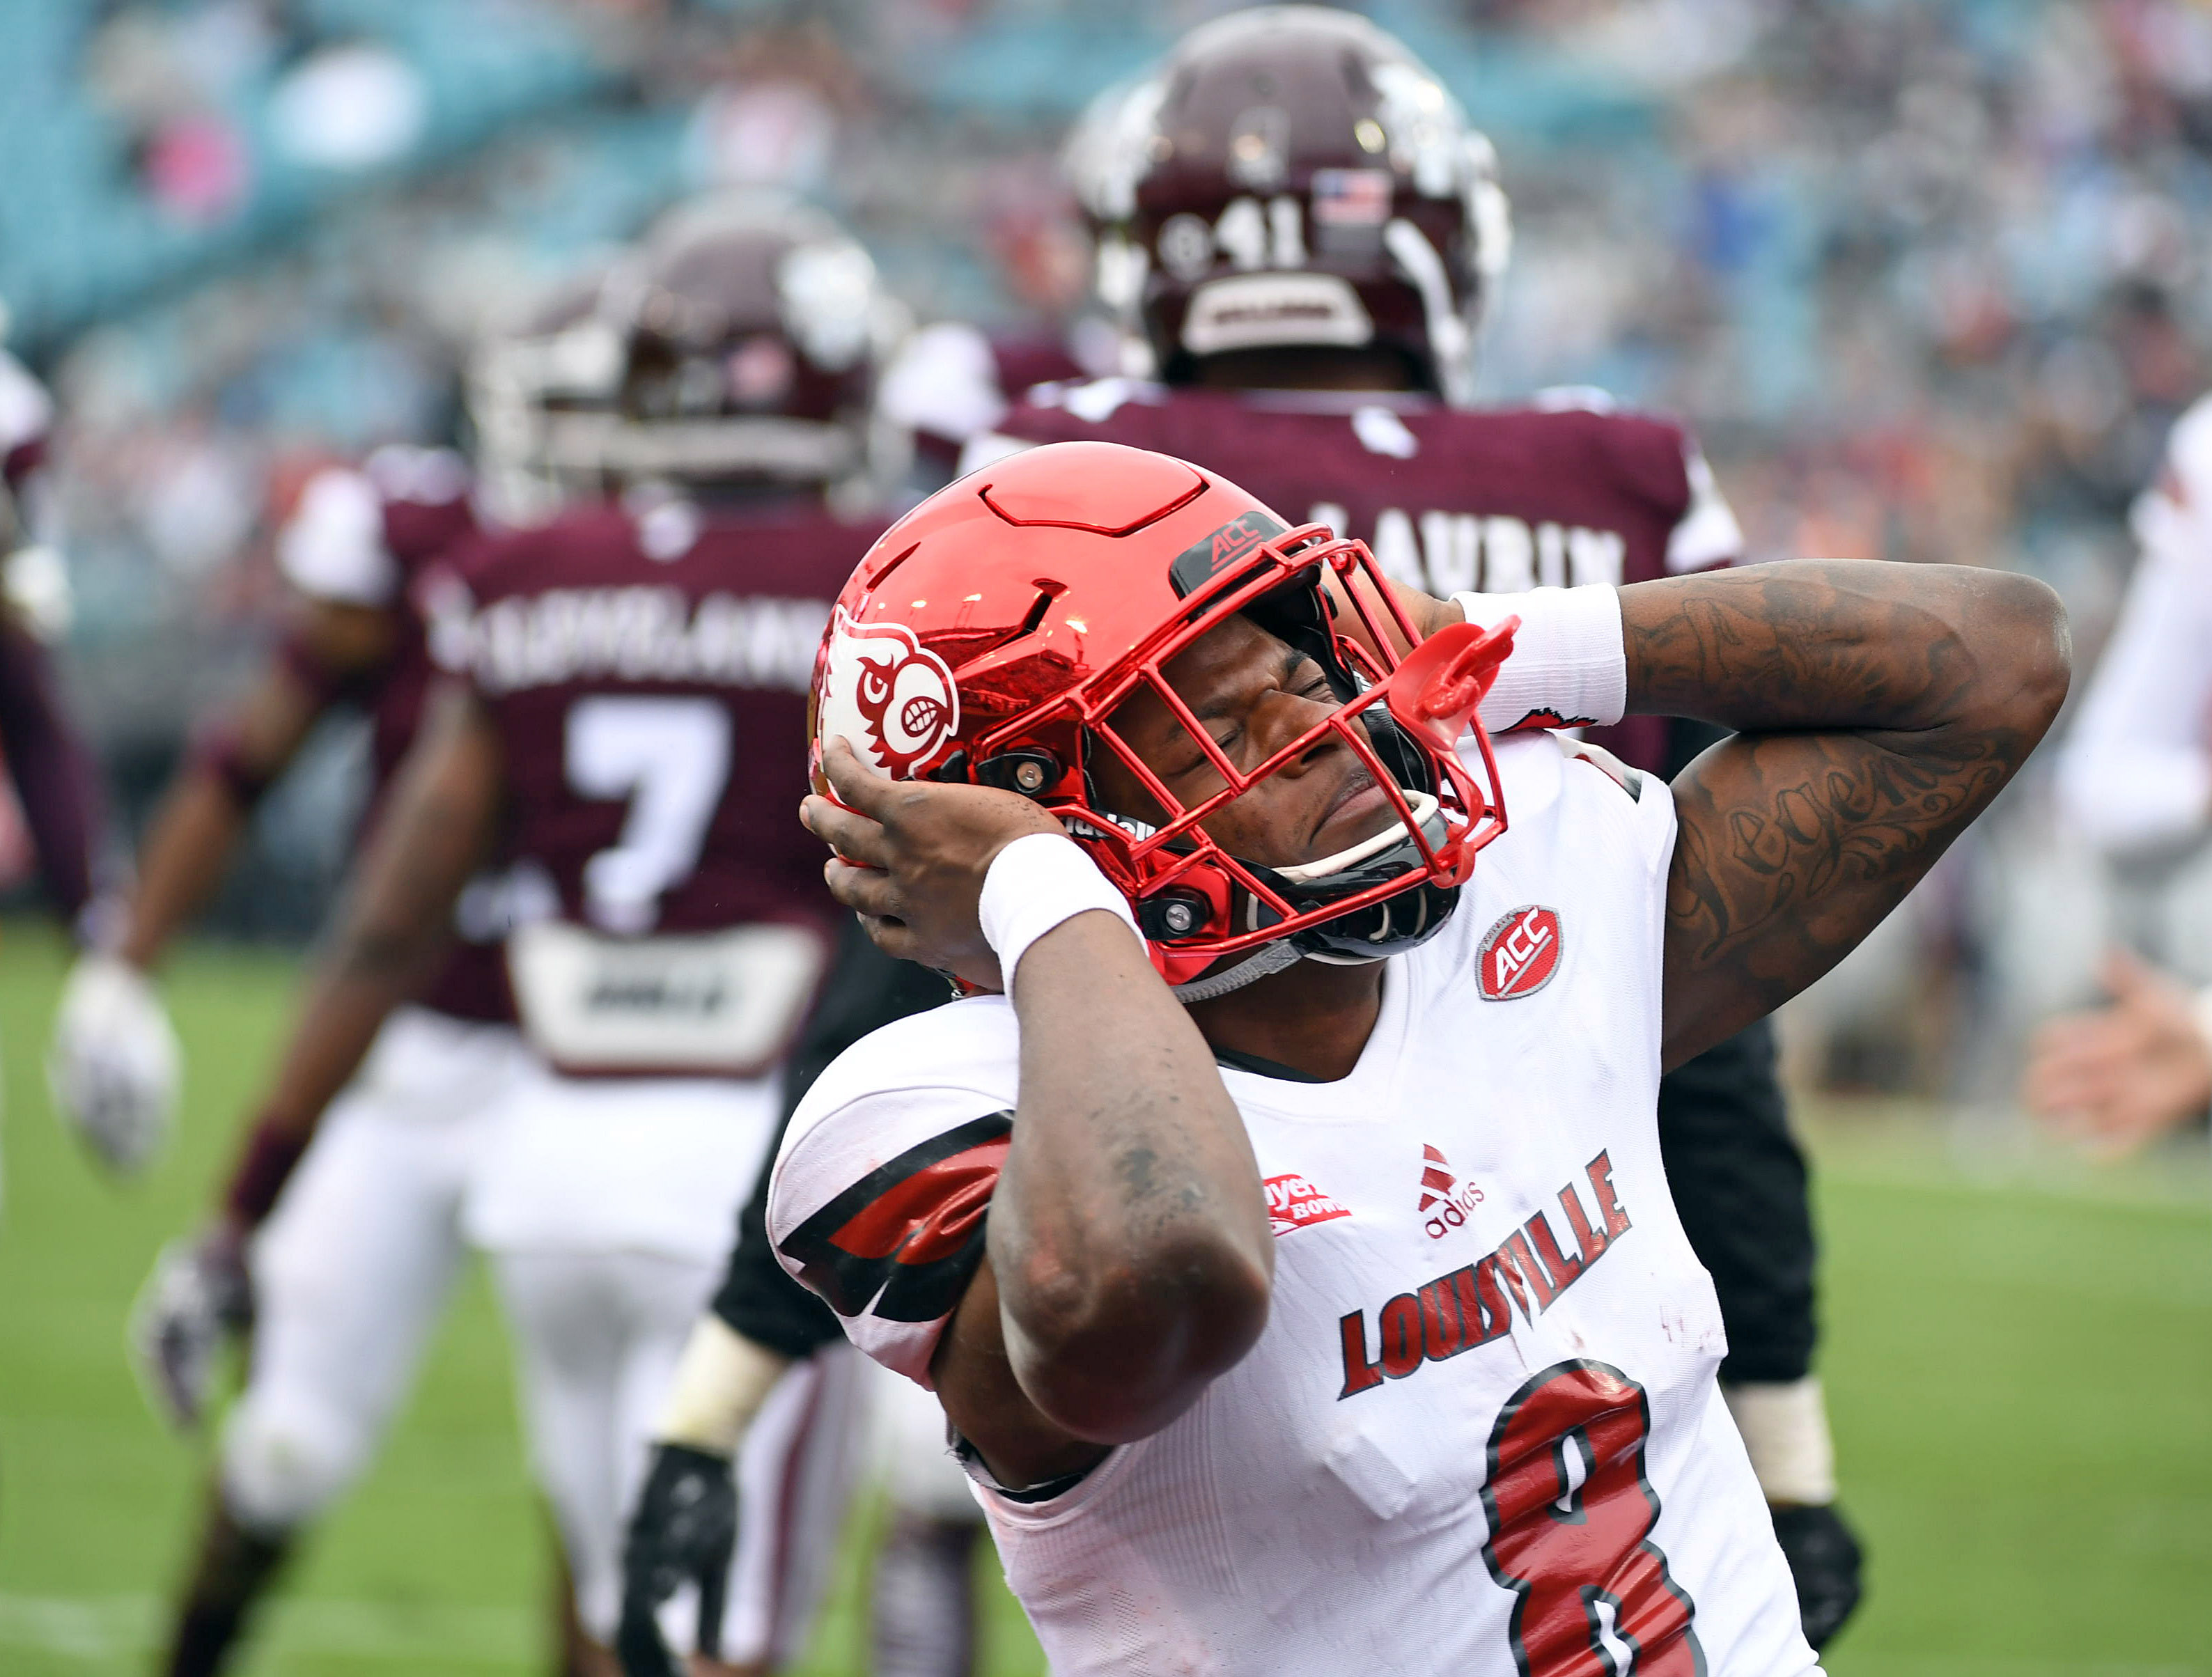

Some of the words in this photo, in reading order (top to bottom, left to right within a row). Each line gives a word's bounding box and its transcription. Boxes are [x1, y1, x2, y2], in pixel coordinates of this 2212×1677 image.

[1210, 194, 1308, 270] 41
[1211, 519, 1259, 563] ACC
[563, 698, 737, 936] 7
[1495, 906, 1550, 989] ACC
[1425, 1182, 1484, 1239] adidas
[1337, 1147, 1633, 1402] LOUISVILLE
[1479, 1358, 1708, 1677] 8
